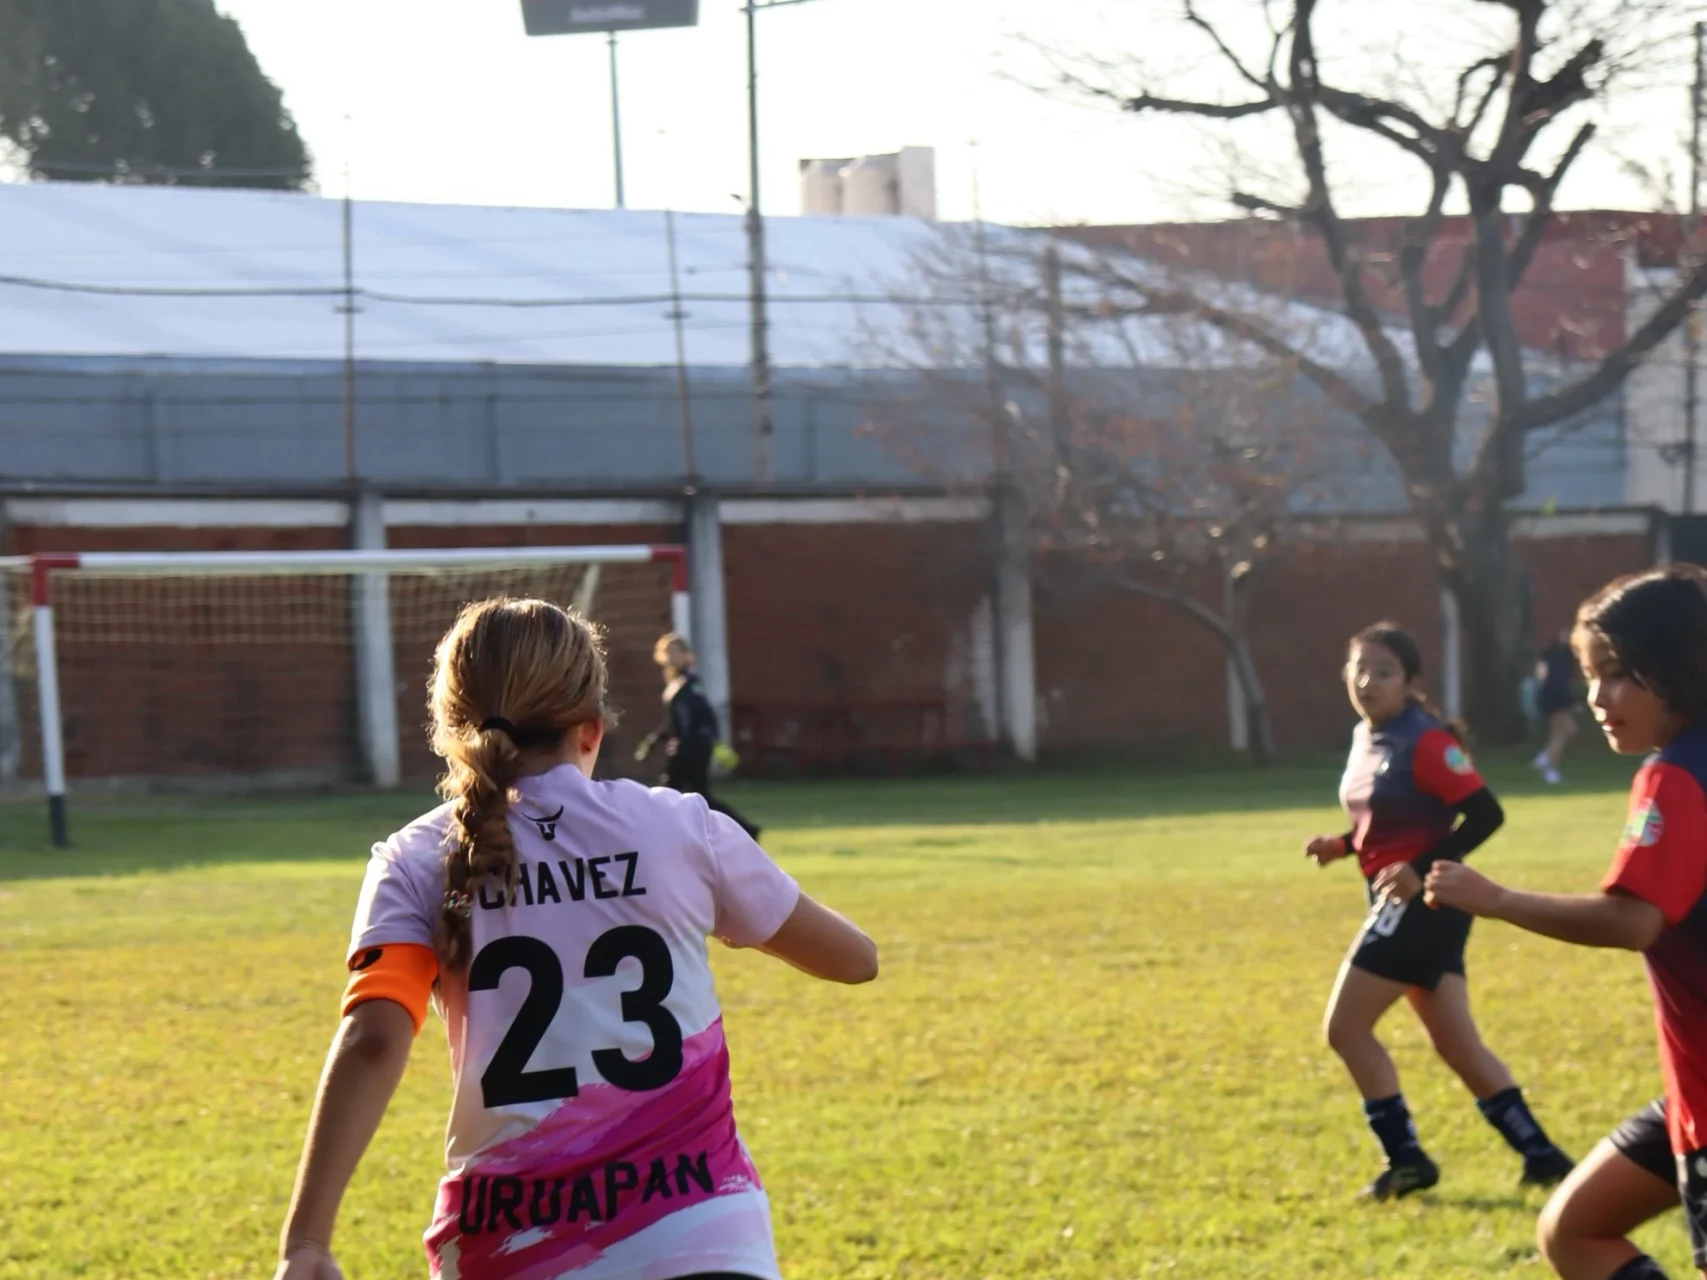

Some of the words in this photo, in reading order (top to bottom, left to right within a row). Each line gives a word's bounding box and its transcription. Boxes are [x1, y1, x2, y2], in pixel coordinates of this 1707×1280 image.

[478, 851, 647, 911] CHAVEZ
[468, 924, 684, 1109] 23
[459, 1150, 715, 1235] URUAPAN
